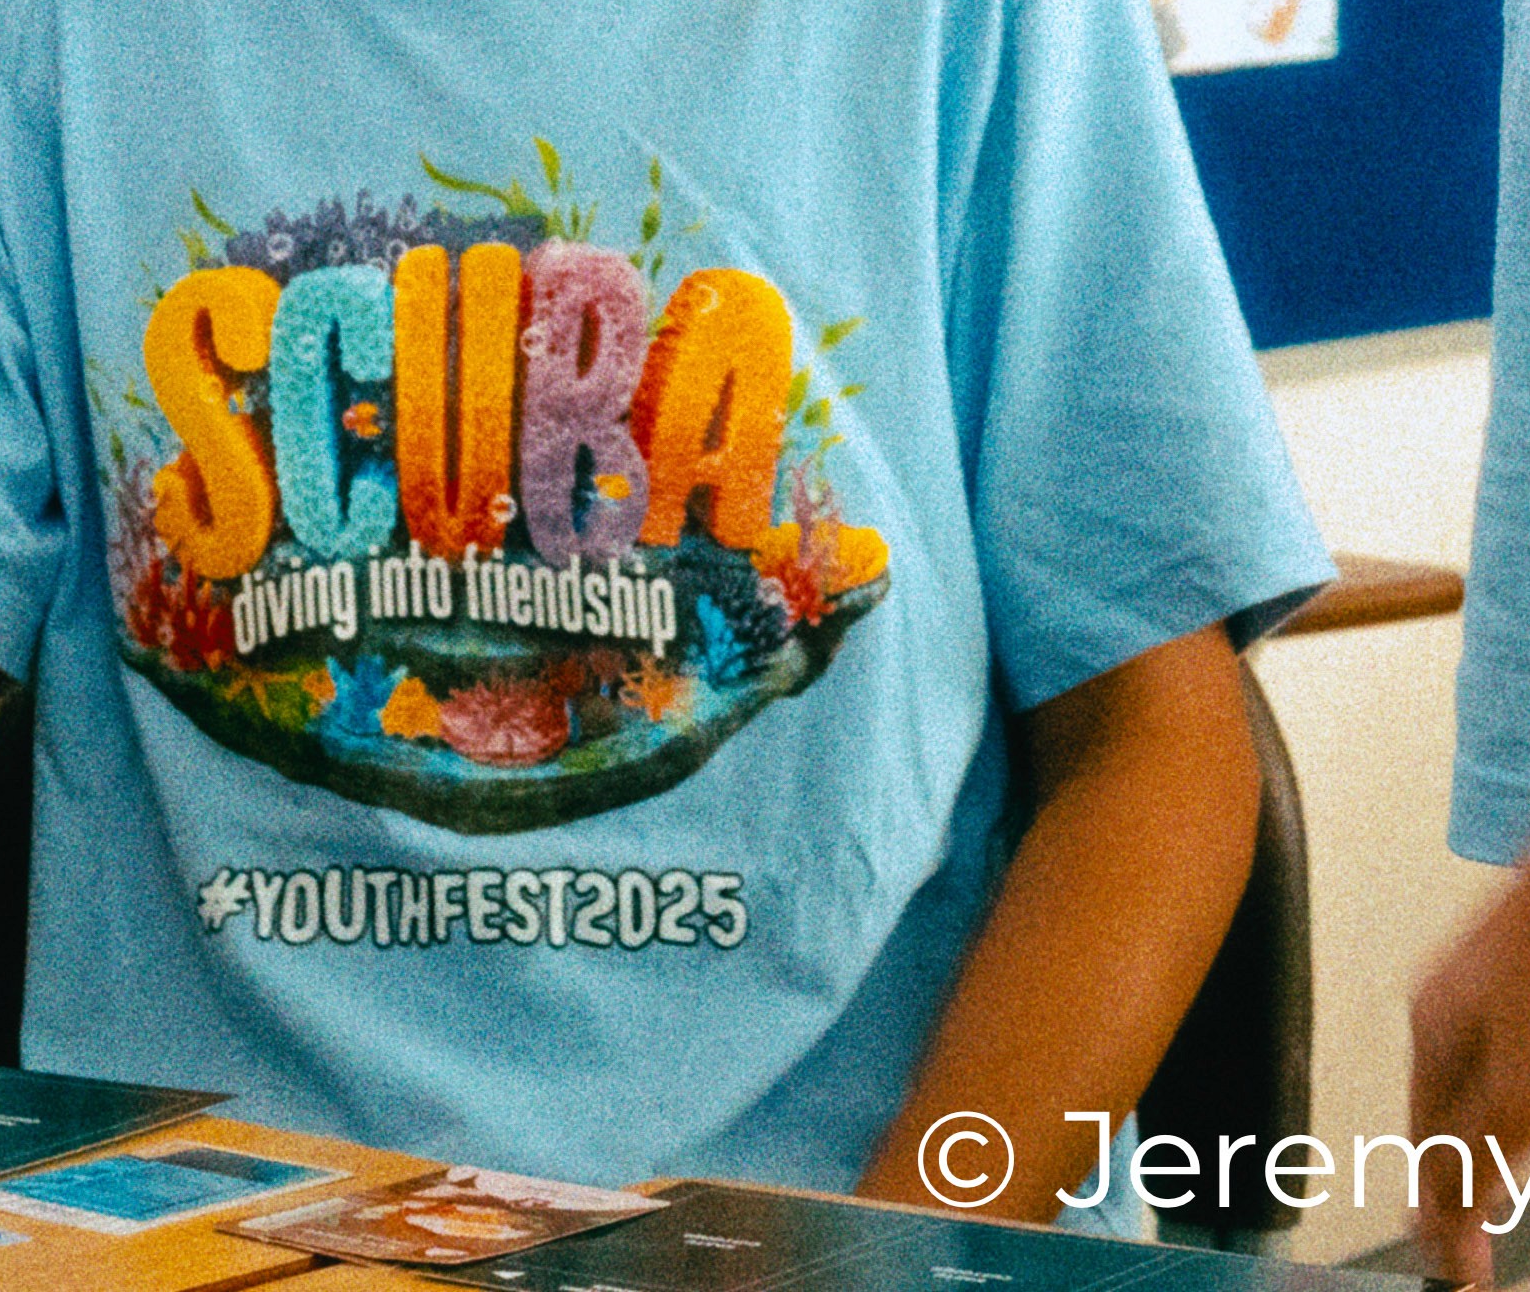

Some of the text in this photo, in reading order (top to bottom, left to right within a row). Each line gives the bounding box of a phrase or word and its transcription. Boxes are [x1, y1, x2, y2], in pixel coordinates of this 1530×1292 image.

[143, 240, 794, 579] SCUBA
[232, 539, 677, 659] diving into friendship
[197, 865, 749, 950] #YOUTHFEST2025
